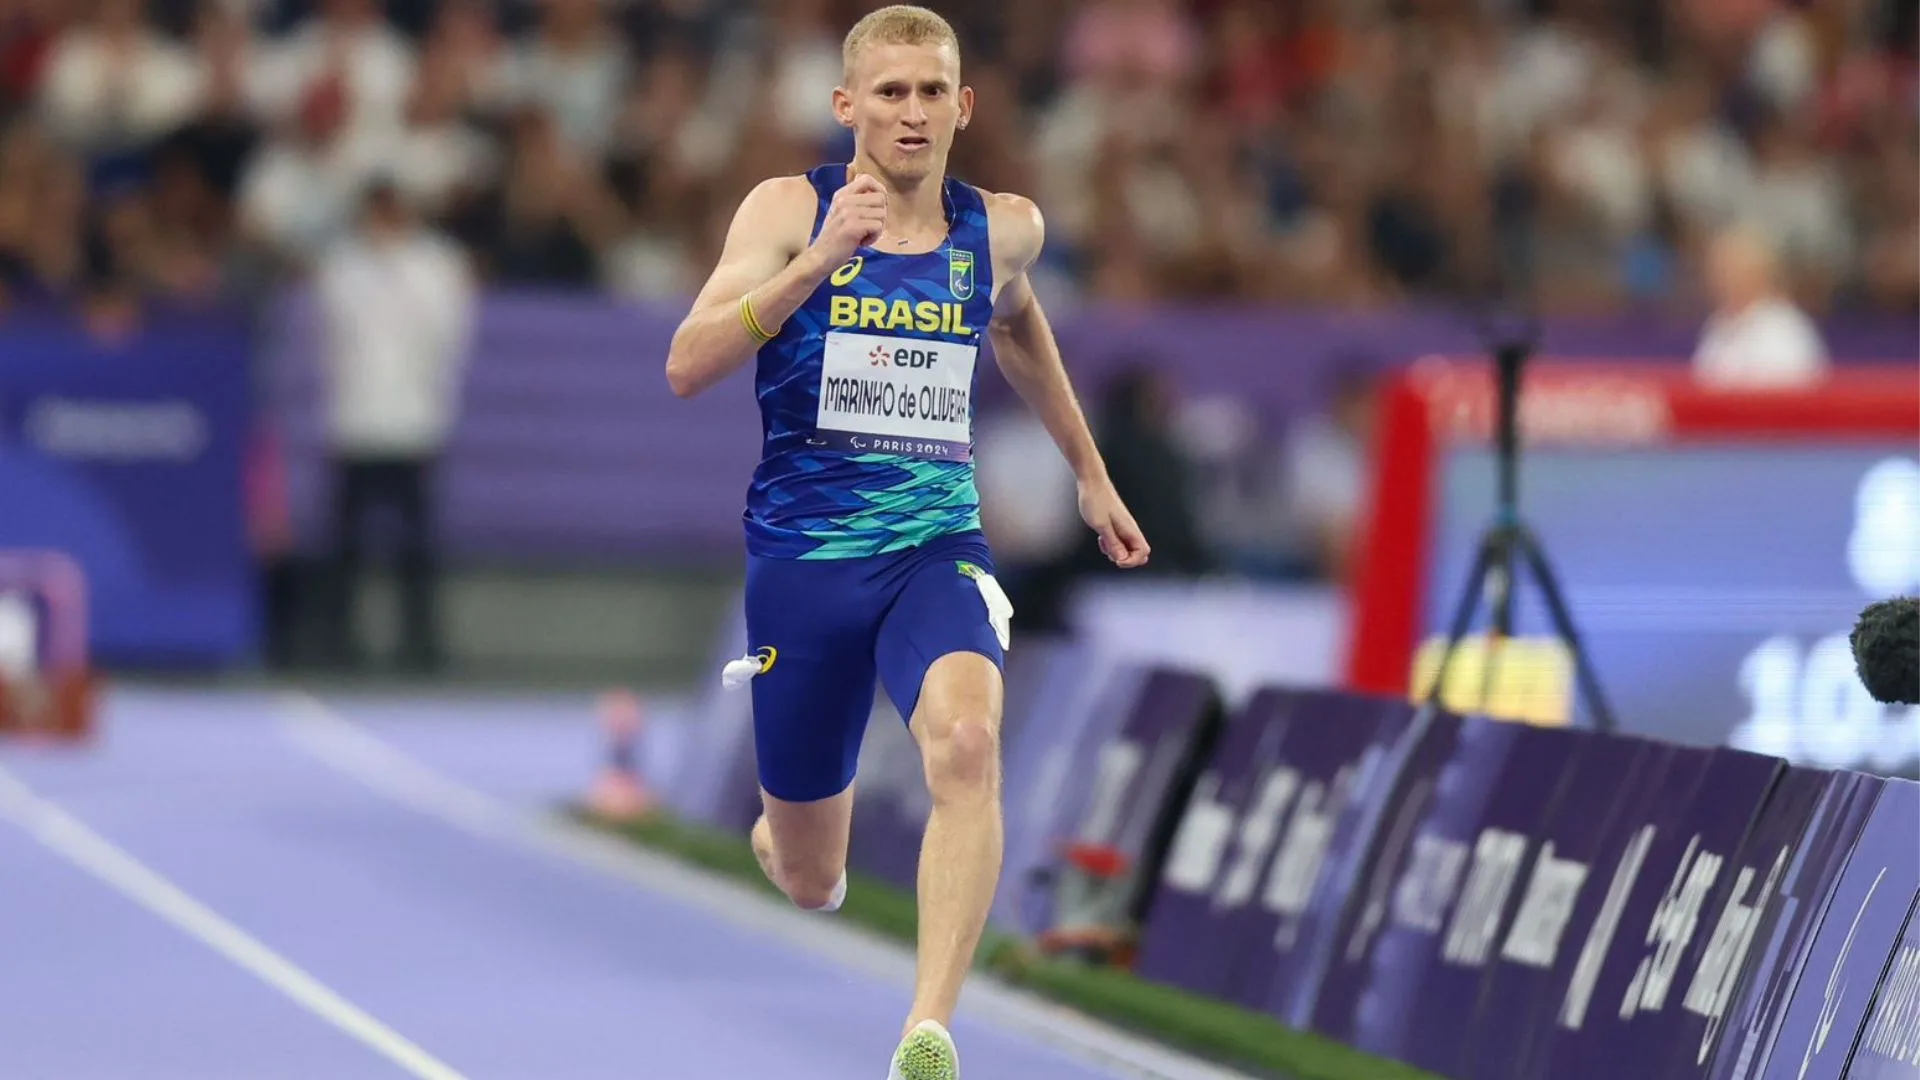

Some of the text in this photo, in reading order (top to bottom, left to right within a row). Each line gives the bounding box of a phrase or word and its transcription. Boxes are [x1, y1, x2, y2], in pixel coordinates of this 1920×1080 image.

[829, 295, 972, 335] BRASIL
[824, 376, 895, 417] MARINHO
[898, 384, 917, 419] de
[873, 439, 949, 456] PARIS 2024
